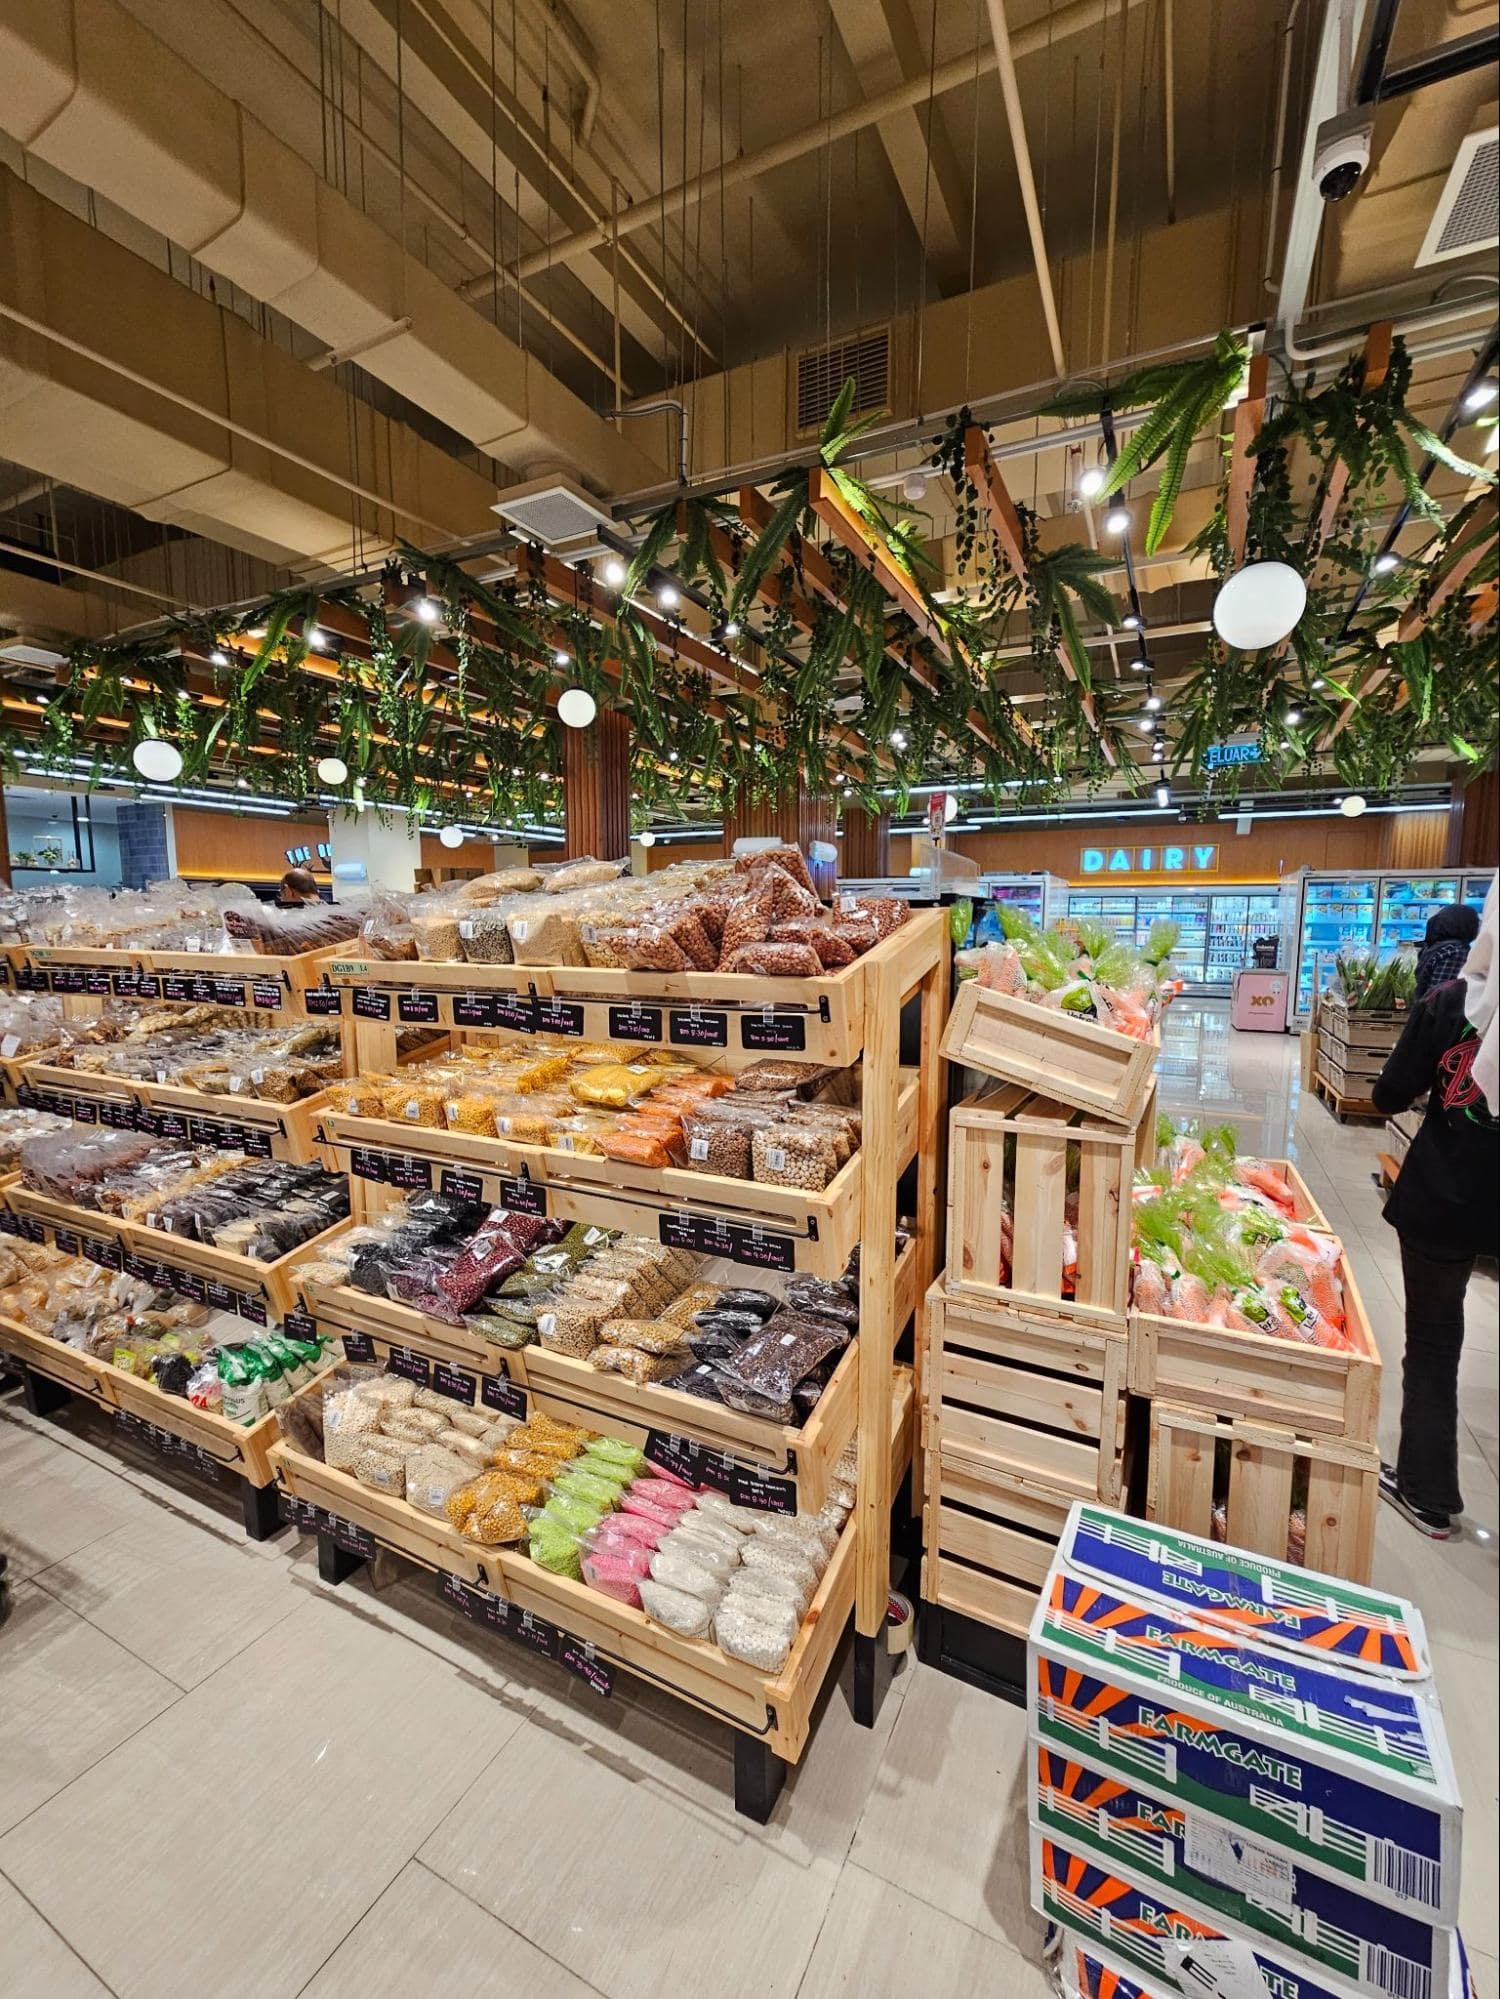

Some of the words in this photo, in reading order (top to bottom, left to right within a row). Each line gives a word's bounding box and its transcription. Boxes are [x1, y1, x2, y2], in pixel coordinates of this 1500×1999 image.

[1083, 846, 1215, 872] DAIRY
[1177, 1539, 1225, 1561] AUSTRALIA
[1225, 1553, 1238, 1564] OF
[1239, 1557, 1281, 1578] PRODUCE
[1161, 1570, 1302, 1630] FARMGATE
[1145, 1624, 1297, 1692] FARMGATE
[1157, 1674, 1206, 1698] PRODUCE
[1207, 1692, 1222, 1706] OF
[1224, 1699, 1284, 1728] AUSTRALIA
[1138, 1705, 1302, 1790] FARMGATE
